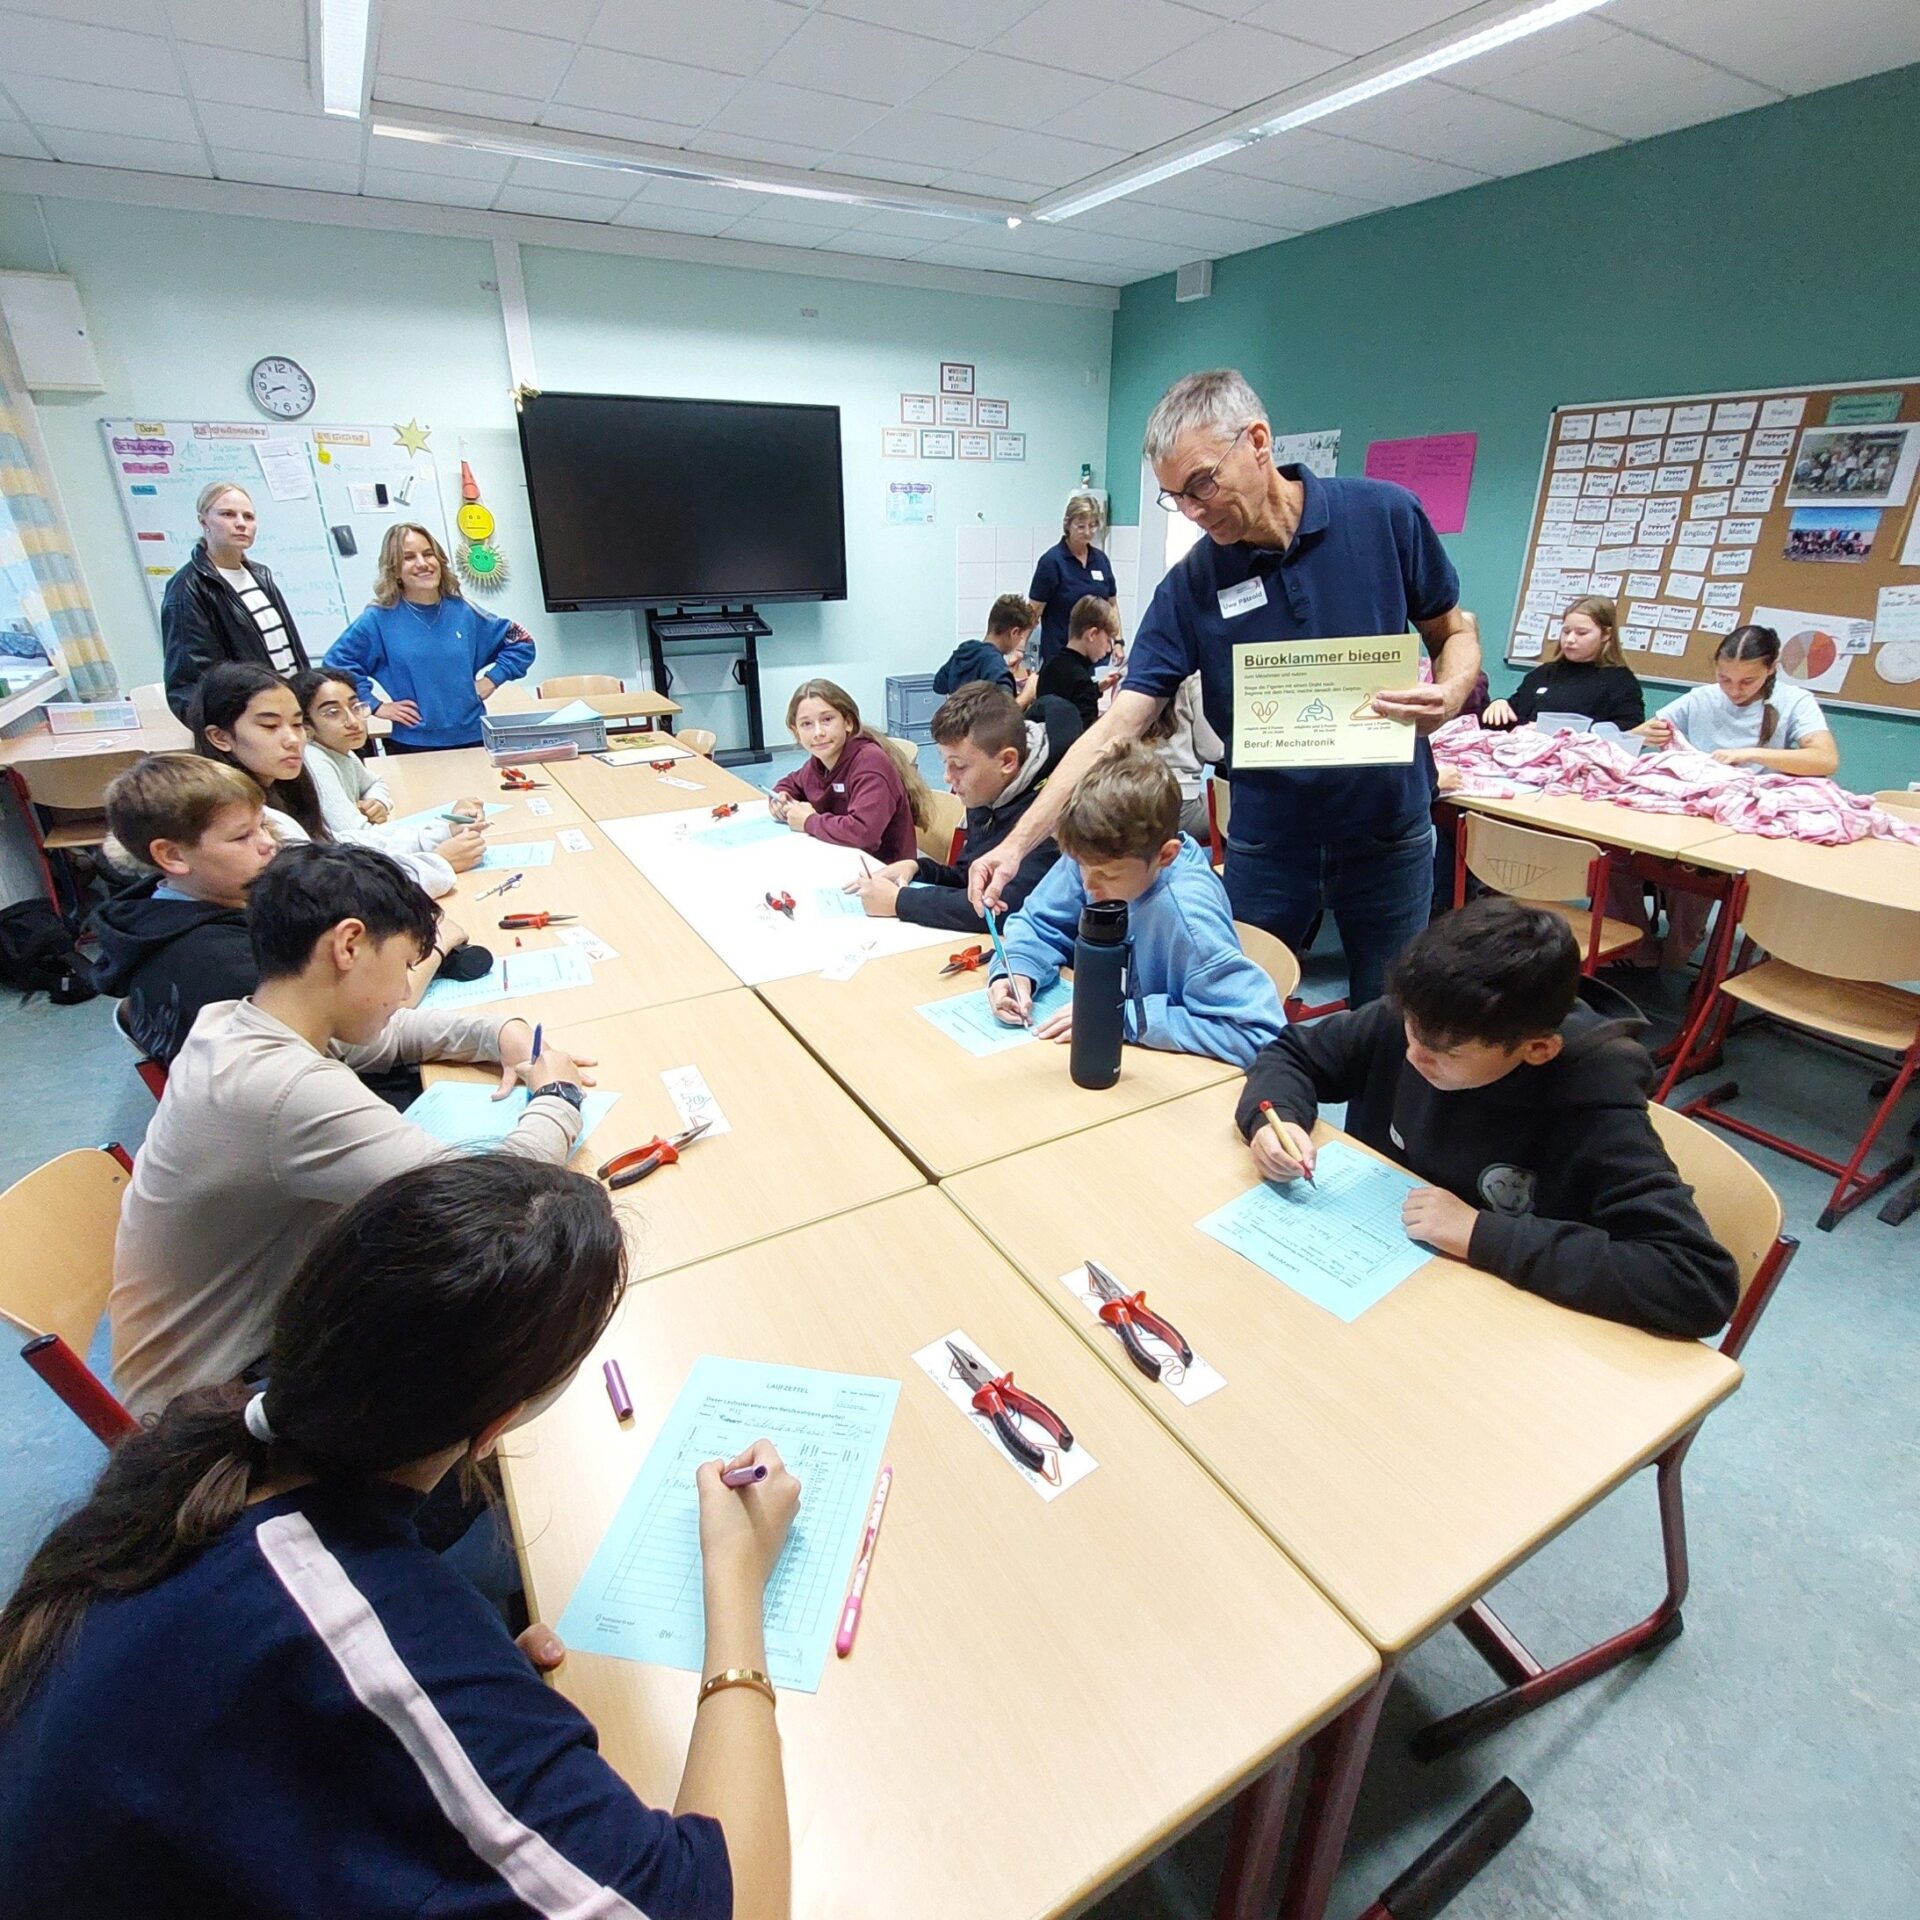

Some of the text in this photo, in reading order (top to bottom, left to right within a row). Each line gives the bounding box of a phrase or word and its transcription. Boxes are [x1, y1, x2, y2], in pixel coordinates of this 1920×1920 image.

[274, 363, 287, 374] 12
[259, 381, 267, 391] 9
[299, 383, 308, 393] 3
[283, 402, 292, 412] 6
[114, 441, 171, 454] Schulplaner
[1635, 449, 1652, 458] Sport
[1695, 502, 1724, 510] Englisch
[1708, 591, 1736, 599] Biologie
[1711, 621, 1724, 629] AG
[1244, 650, 1401, 667] Büroklammer biegen
[1244, 738, 1336, 749] Beruf: Mechatronik
[766, 1383, 809, 1394] LAUFZETTEL
